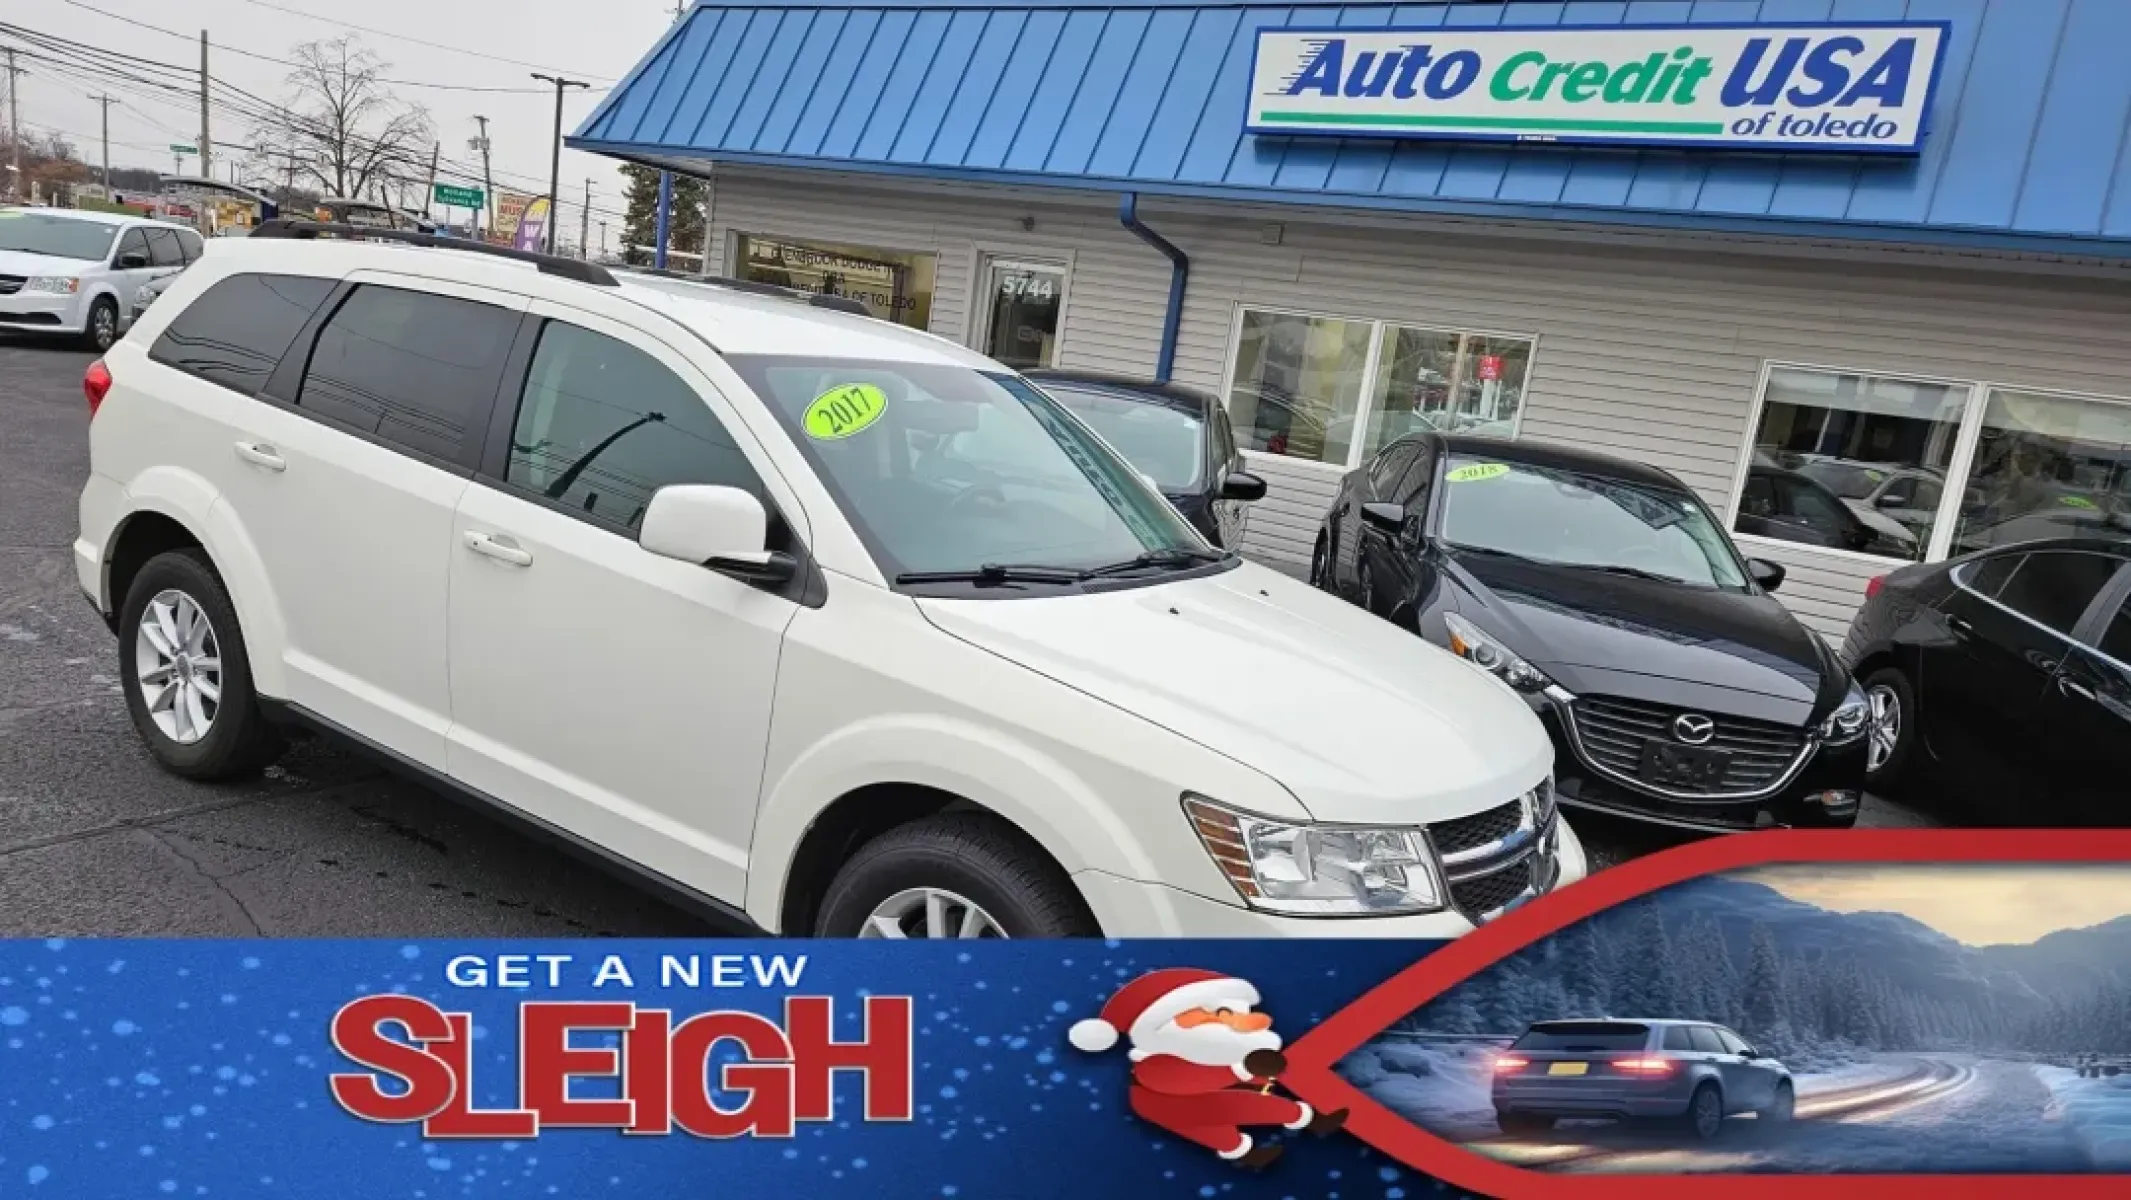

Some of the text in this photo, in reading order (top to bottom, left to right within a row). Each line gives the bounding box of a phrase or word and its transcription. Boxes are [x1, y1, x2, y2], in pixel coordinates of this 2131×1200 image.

[1280, 36, 1917, 107] Auto Credit USA
[1731, 111, 1898, 138] of toledo
[1003, 276, 1052, 299] 5744
[871, 293, 917, 310] TOLEDO
[818, 387, 871, 434] 2017
